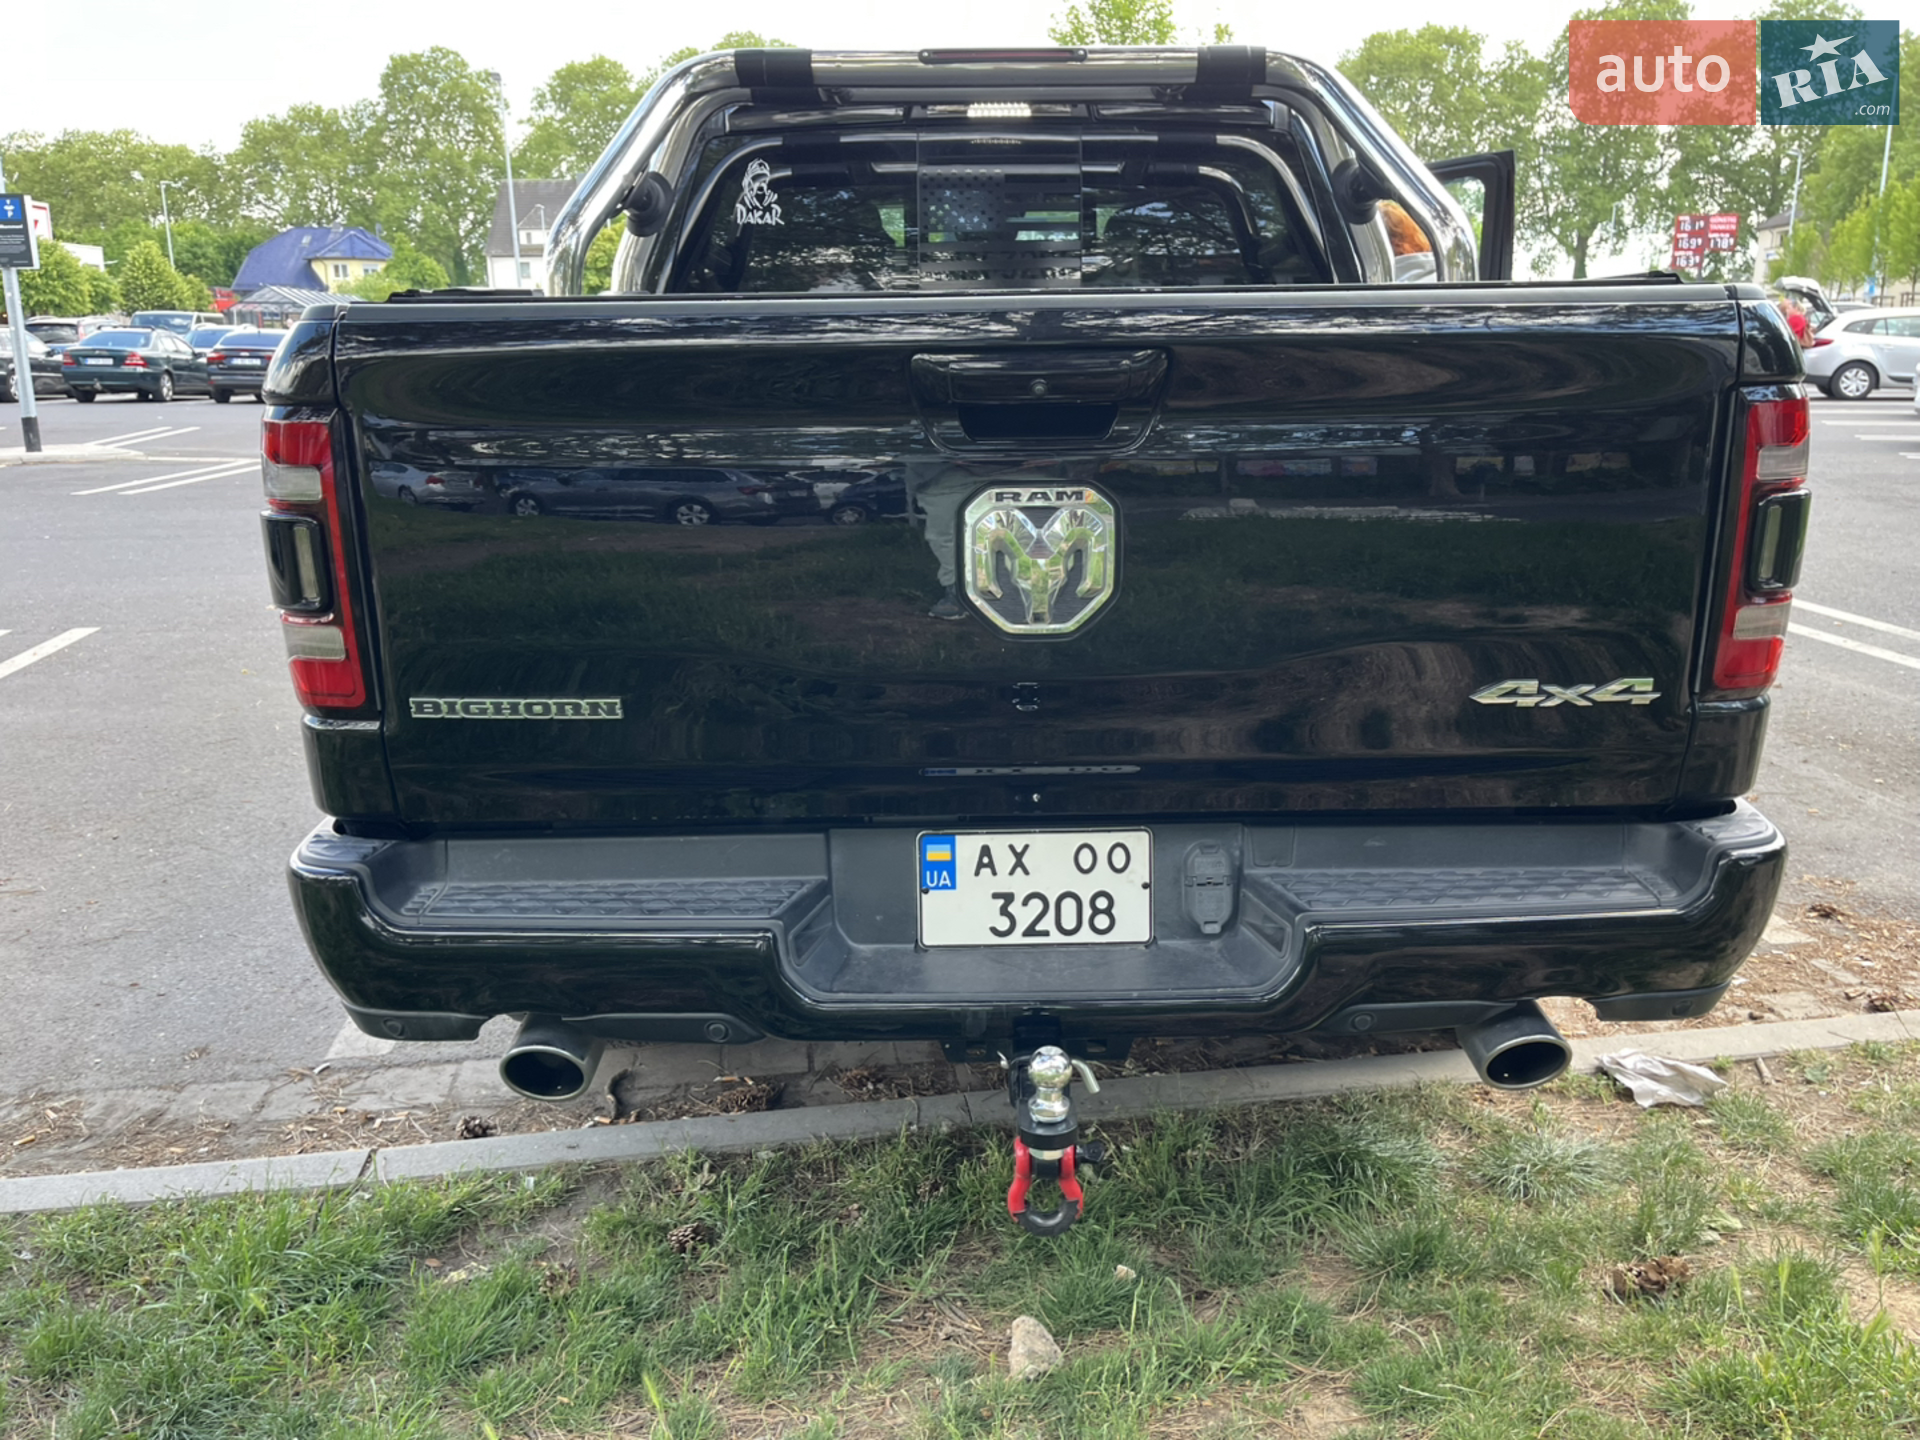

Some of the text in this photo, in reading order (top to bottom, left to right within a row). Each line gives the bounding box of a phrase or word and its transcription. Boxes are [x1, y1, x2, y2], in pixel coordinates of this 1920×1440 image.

[736, 203, 785, 226] DAKAR
[995, 491, 1084, 503] RAM
[409, 697, 624, 719] BIGHORN
[974, 843, 1030, 877] AX
[926, 870, 952, 887] UA
[989, 890, 1116, 938] 3208
